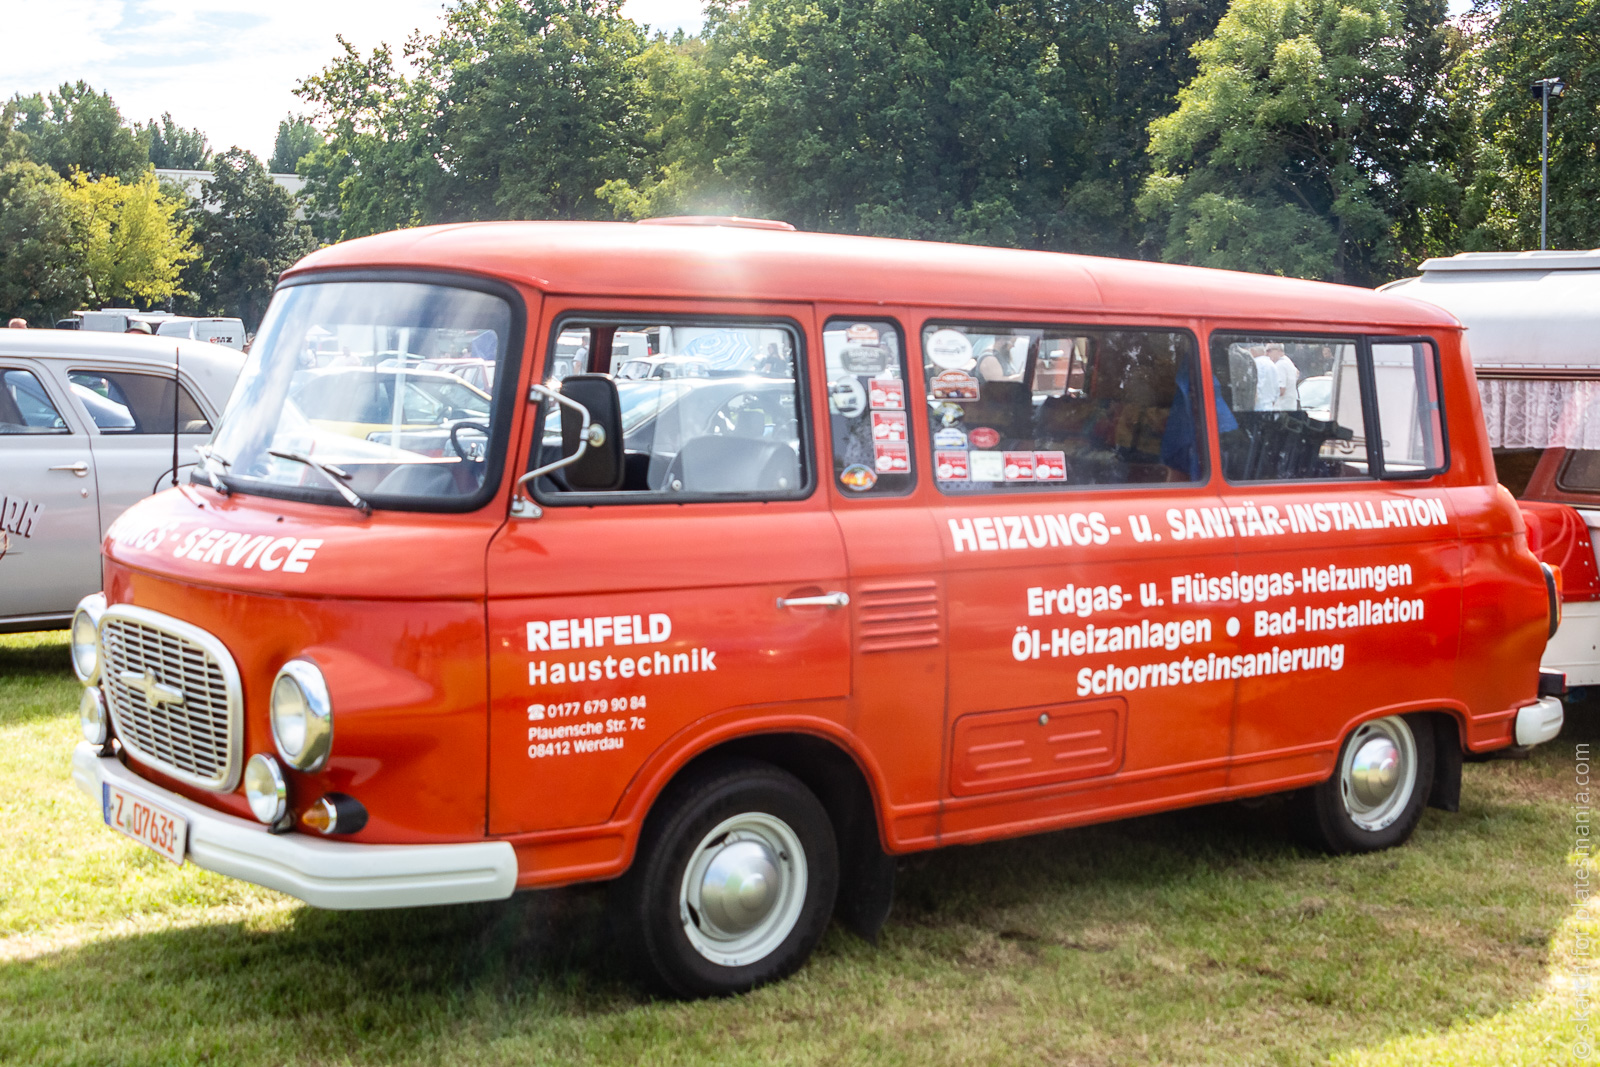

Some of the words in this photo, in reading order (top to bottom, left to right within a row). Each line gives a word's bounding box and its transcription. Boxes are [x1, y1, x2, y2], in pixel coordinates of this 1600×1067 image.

[948, 512, 1122, 552] HEIZUNGS-
[1128, 514, 1162, 543] u.
[1166, 498, 1448, 541] SANITÄR-INSTALLATION
[1027, 584, 1132, 617] Erdgas-
[1139, 582, 1164, 607] u.
[1171, 563, 1412, 605] Flüssiggas-Heizungen
[526, 613, 672, 652] REHFELD
[1012, 617, 1212, 662] Öl-Heizanlagen
[1254, 596, 1424, 637] Bad-Installation
[528, 647, 717, 686] Haustechnik
[1076, 644, 1344, 697] Schornsteinsanierung
[528, 720, 604, 741] Plauensche
[606, 718, 627, 733] Str.
[630, 716, 646, 730] 7c
[547, 701, 581, 719] 0177
[583, 699, 609, 715] 679
[611, 697, 628, 712] 90
[629, 695, 647, 710] 84
[528, 741, 570, 758] 08412
[573, 737, 624, 753] Werdau
[115, 793, 125, 827] Z
[133, 802, 175, 854] 07631
